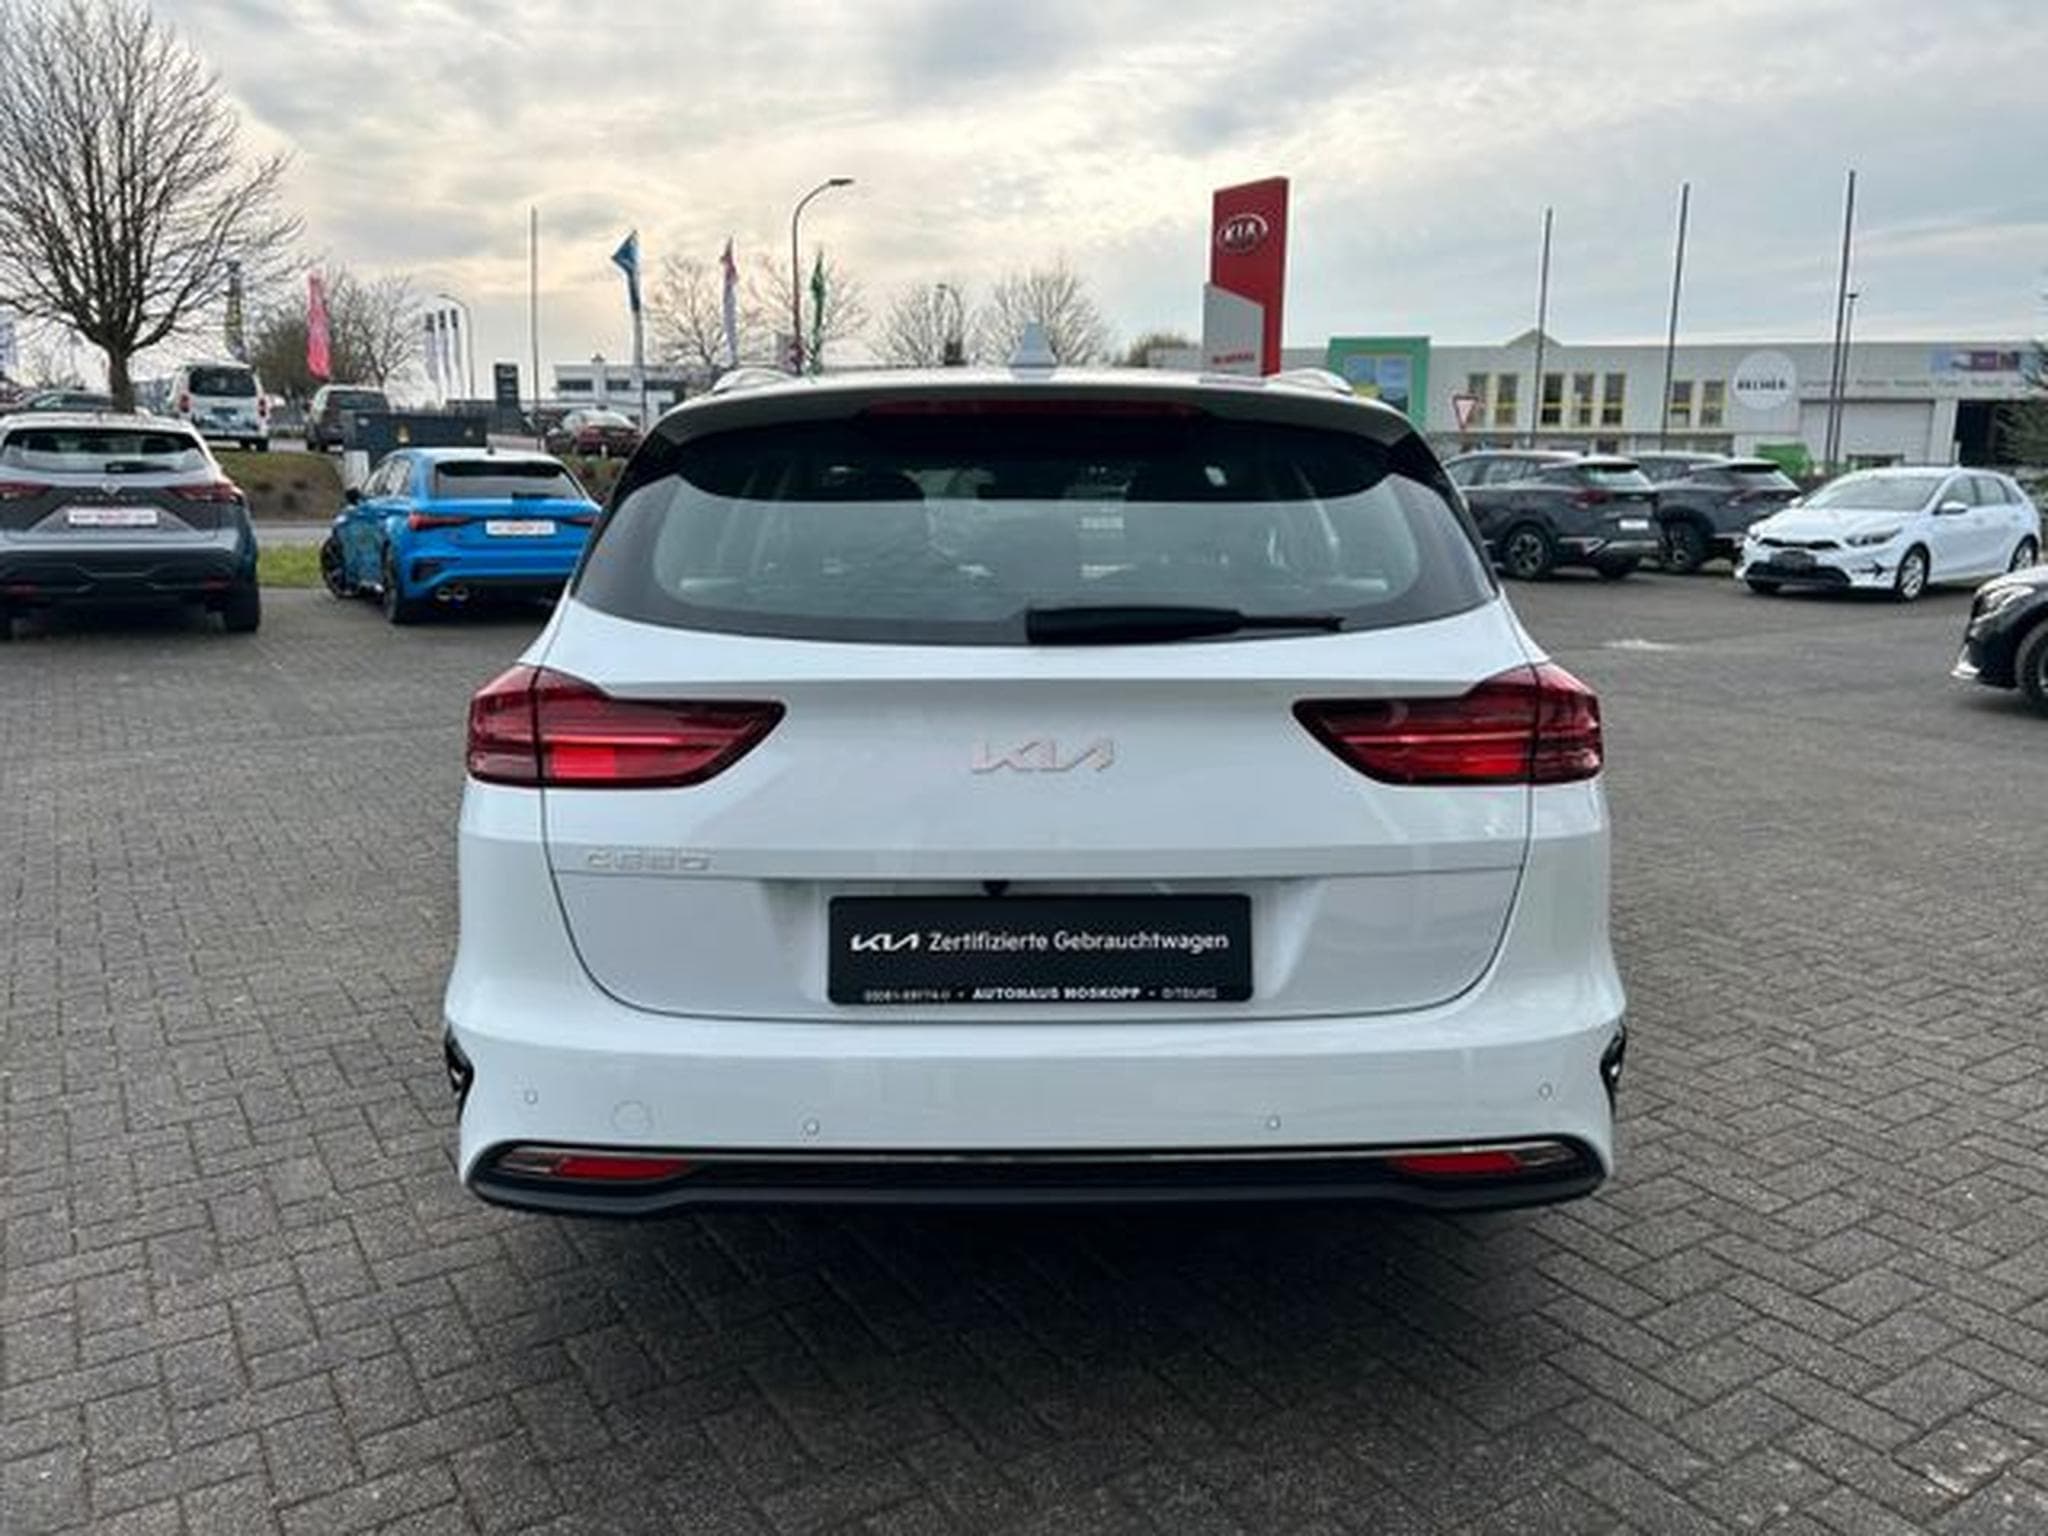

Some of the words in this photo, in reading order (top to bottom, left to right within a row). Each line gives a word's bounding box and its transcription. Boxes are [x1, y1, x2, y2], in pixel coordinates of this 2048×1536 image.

[972, 737, 1115, 773] KIA
[851, 933, 919, 951] KIA
[929, 931, 1048, 951] Zertifizierte
[1054, 931, 1230, 954] Gebrauchtwagen
[972, 988, 1060, 1000] AUTOHAUS
